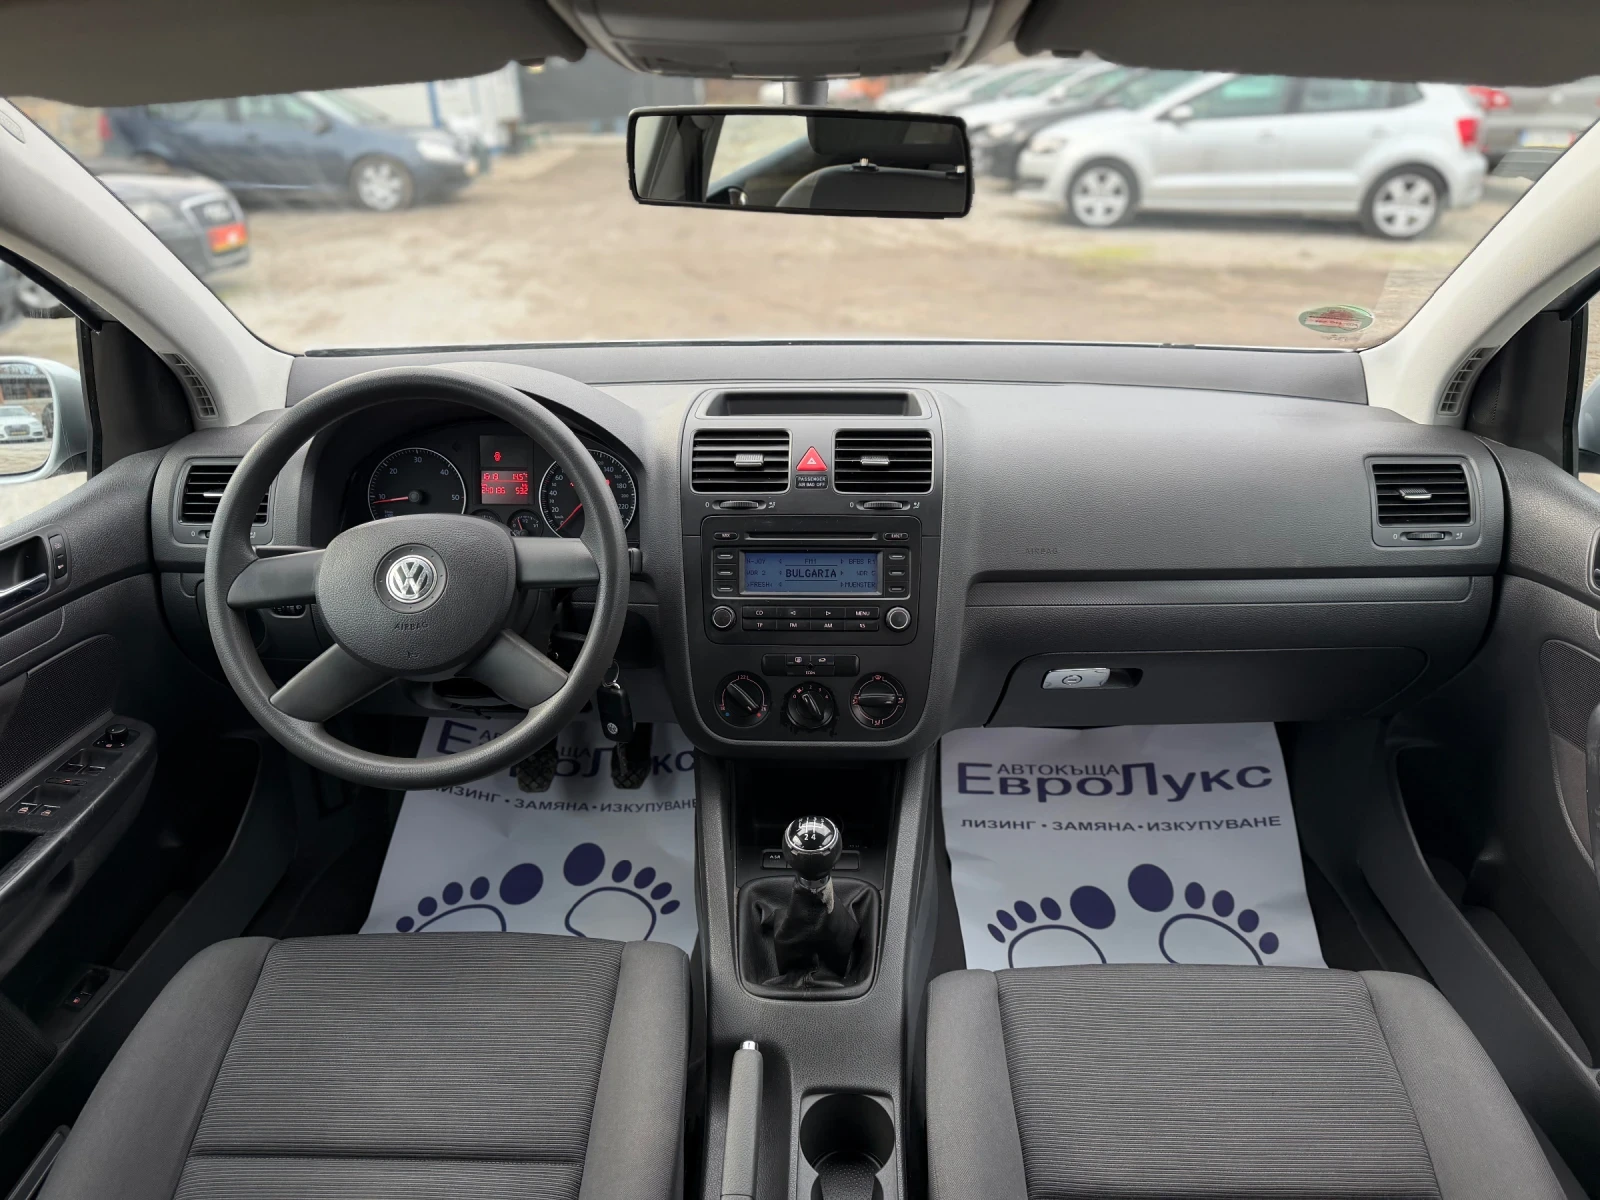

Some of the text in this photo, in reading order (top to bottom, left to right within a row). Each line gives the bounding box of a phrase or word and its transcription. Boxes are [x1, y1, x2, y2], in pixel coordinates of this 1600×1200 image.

[785, 568, 837, 578] BULGARIA
[394, 621, 428, 631] AIRBAG
[996, 763, 1121, 778] АВТОКЪЩА
[435, 785, 502, 803] ИЗИНГ
[514, 798, 589, 812] ЗАМЯНА
[961, 815, 1283, 833] ЛИЗИНГ ЗАМЯНА ИЗКУПУВАНЕ
